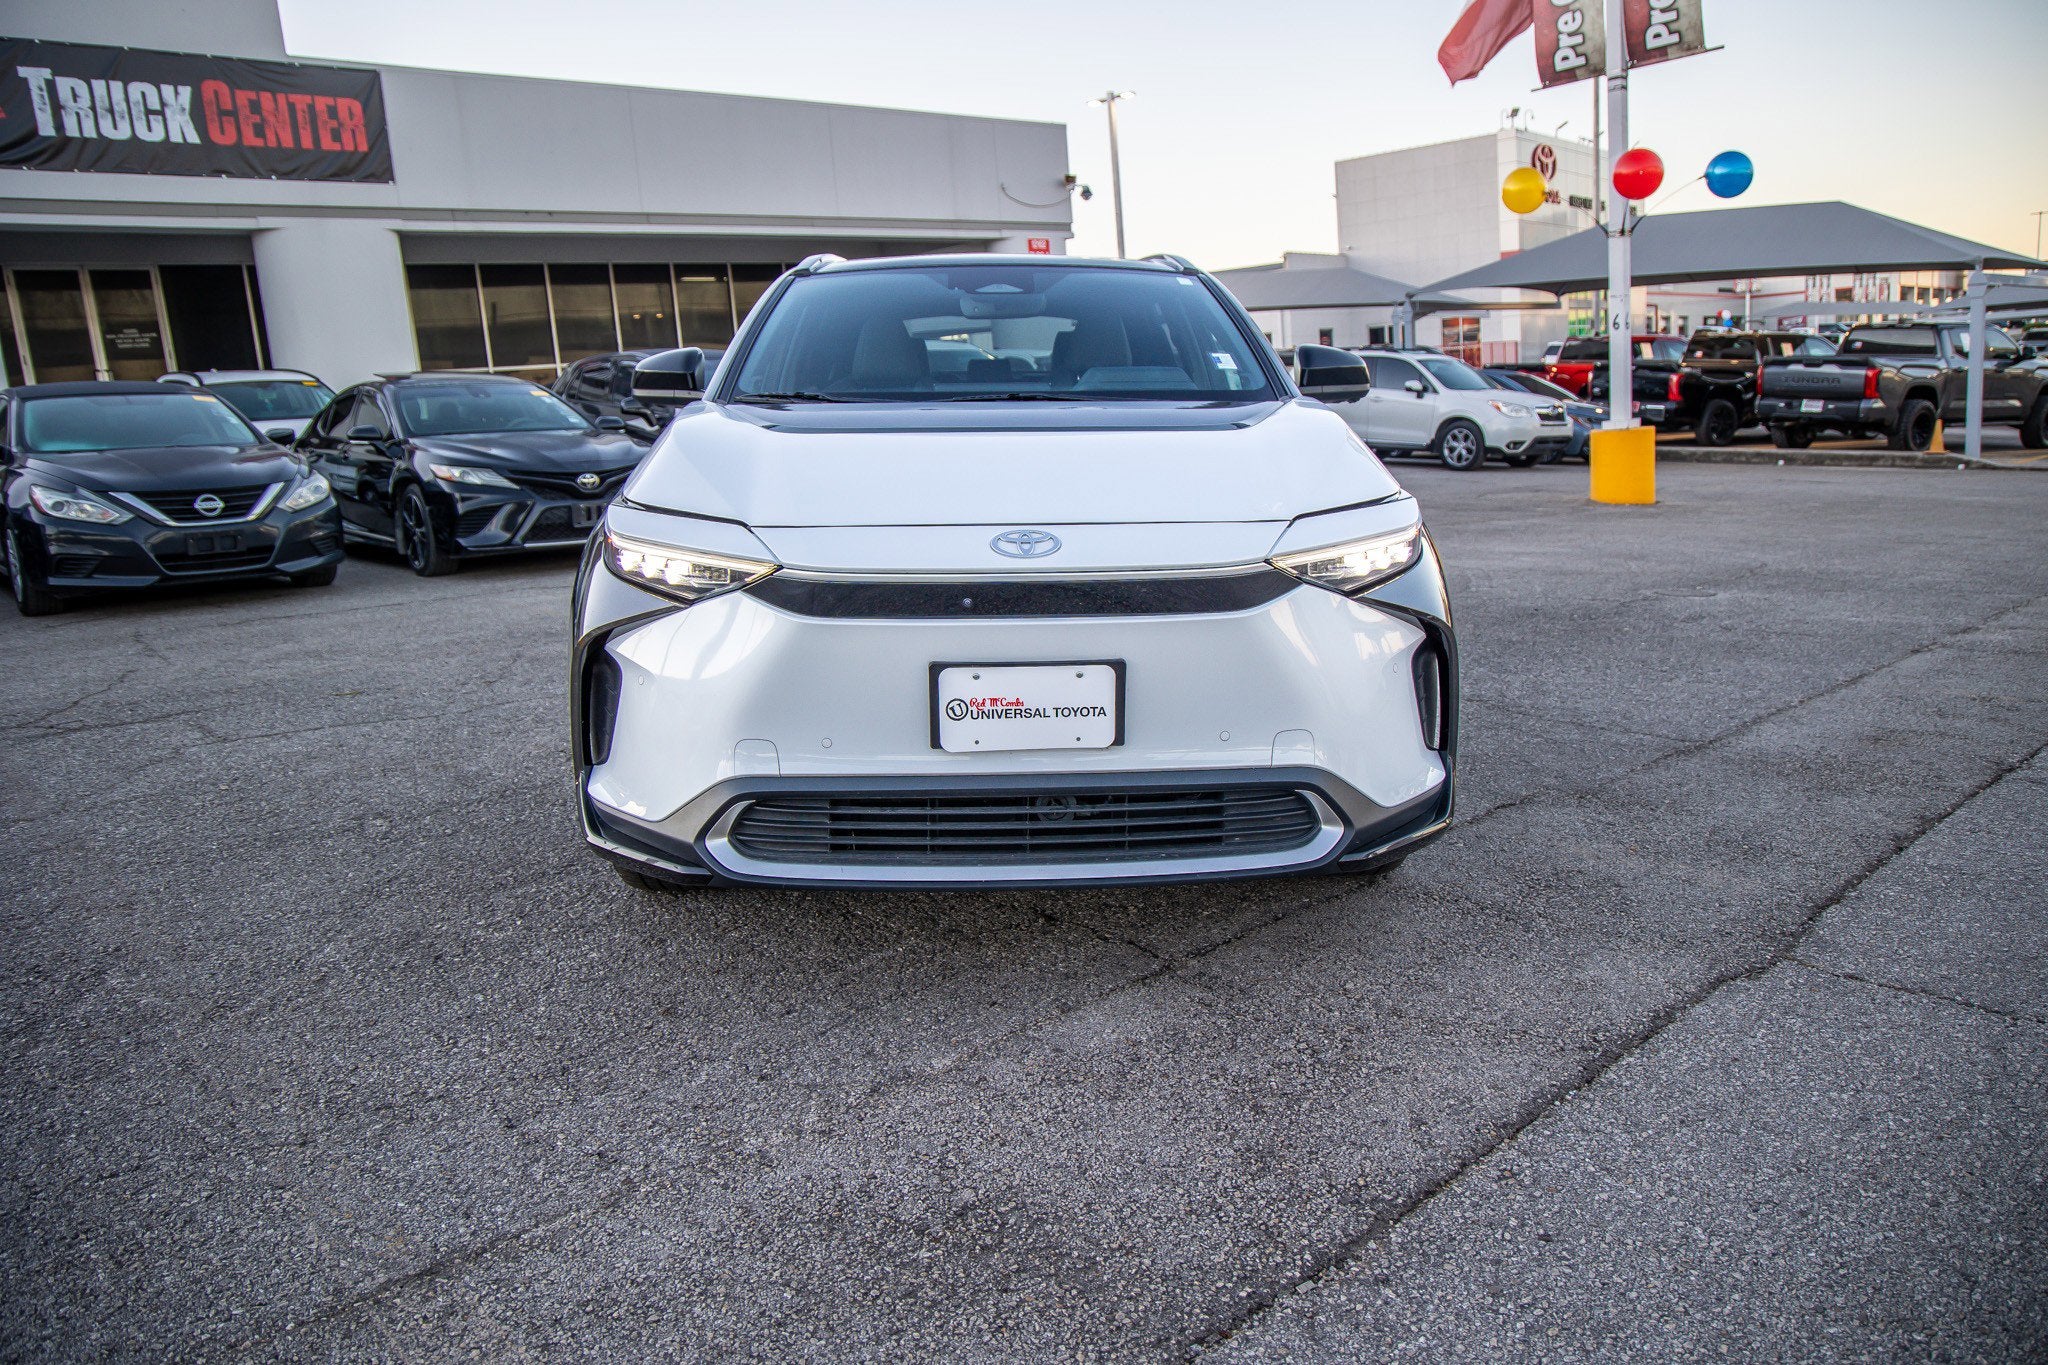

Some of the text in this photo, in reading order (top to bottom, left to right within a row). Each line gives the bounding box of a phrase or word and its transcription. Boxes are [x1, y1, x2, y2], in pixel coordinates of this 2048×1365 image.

[1553, 0, 1588, 72] Pre
[17, 66, 369, 153] TRUCK CENTER
[1613, 312, 1620, 330] 6
[1782, 376, 1841, 386] TUNDRA
[969, 697, 986, 711] Red
[970, 705, 1107, 720] UNIVERSAL TOYOTA
